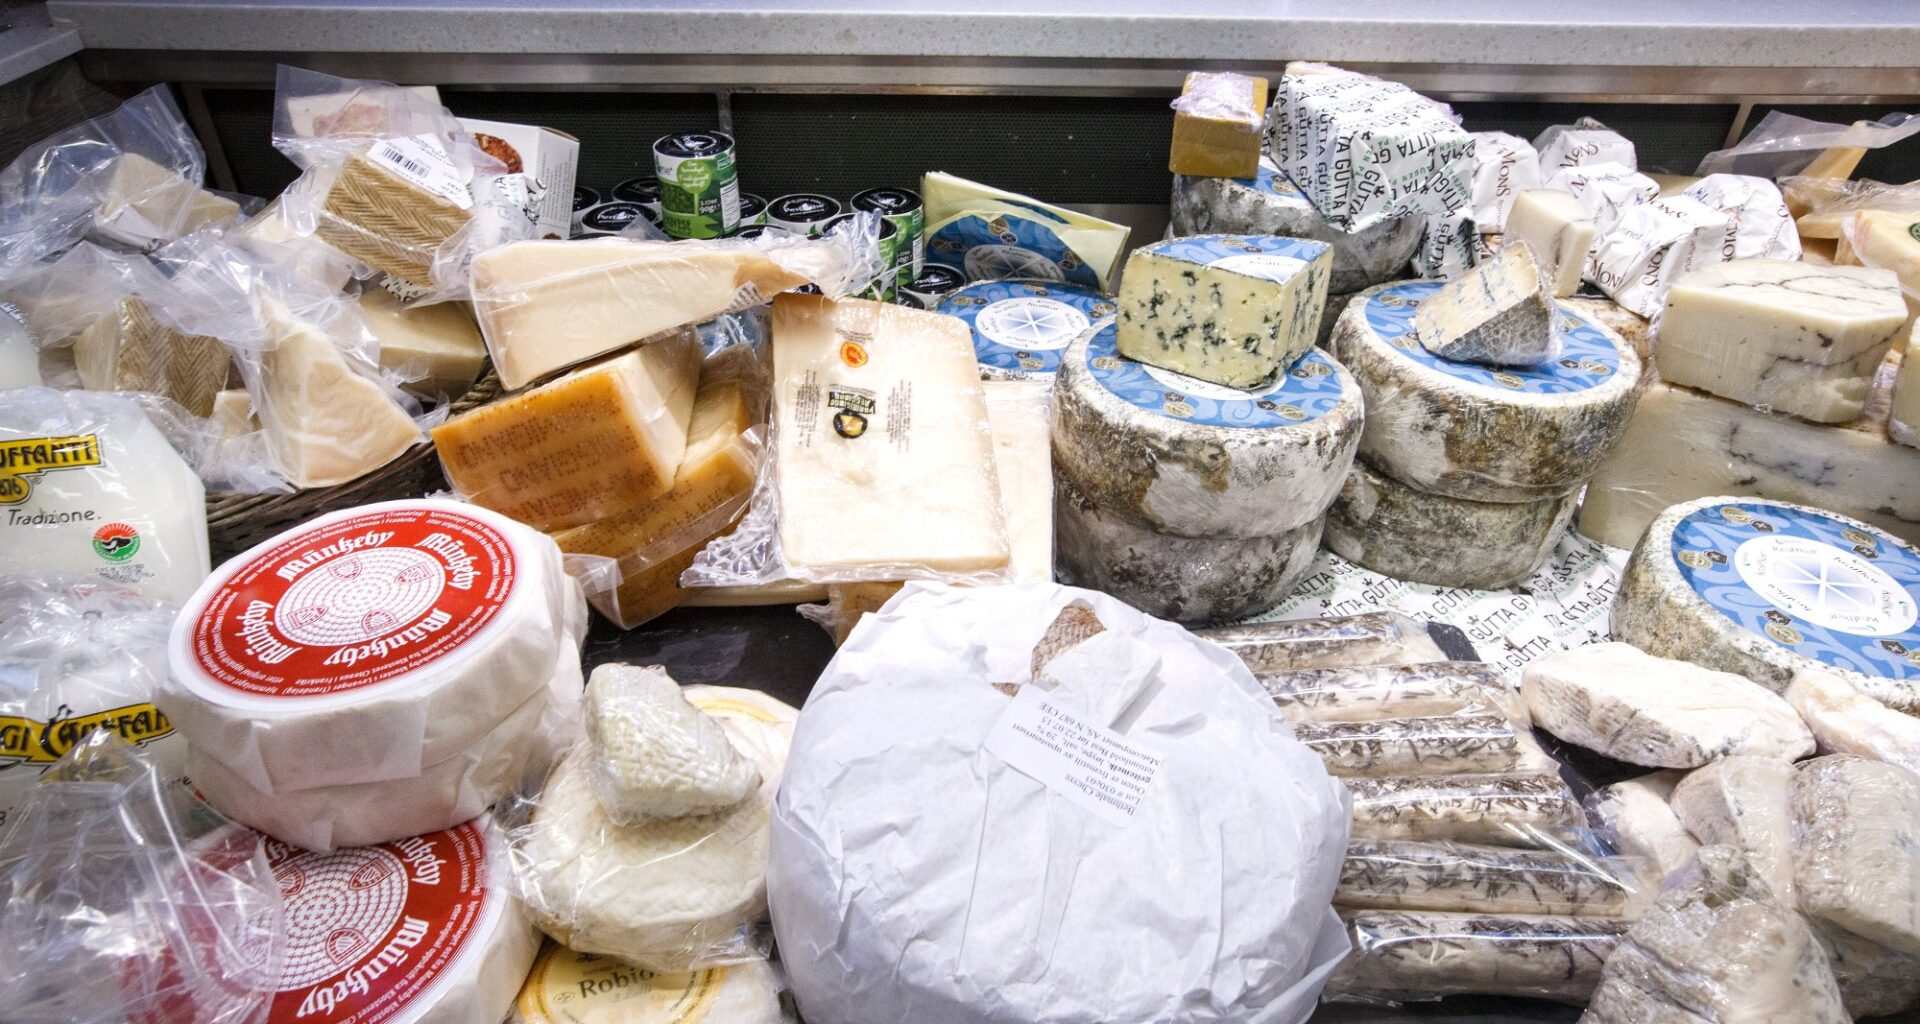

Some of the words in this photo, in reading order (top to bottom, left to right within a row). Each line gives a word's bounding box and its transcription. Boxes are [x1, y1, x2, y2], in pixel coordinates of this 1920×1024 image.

[1299, 107, 1308, 160] GUTTA
[1333, 160, 1352, 209] GUTTA
[1349, 170, 1380, 214] GUTTA
[0, 441, 94, 468] UFFANTI
[8, 508, 102, 526] Tradizione.
[1552, 550, 1588, 584] GUTTA
[1469, 607, 1518, 640] GUTTA
[1507, 634, 1551, 668] GUTTA
[1059, 713, 1075, 725] 687
[1076, 722, 1084, 730] N
[1046, 730, 1058, 741] 29
[1077, 734, 1090, 745] før
[1085, 726, 1102, 739] AS,
[1064, 751, 1074, 759] av
[1090, 742, 1109, 756] Best
[1101, 735, 1160, 767] Matcompaniet
[1074, 757, 1109, 779] fremstilt
[1064, 774, 1094, 794] Chevre
[1120, 779, 1146, 795] Osten
[1094, 790, 1136, 815] Bethmale
[1125, 793, 1141, 805] Lot
[395, 837, 447, 885] nkeby
[578, 968, 654, 998] Robio
